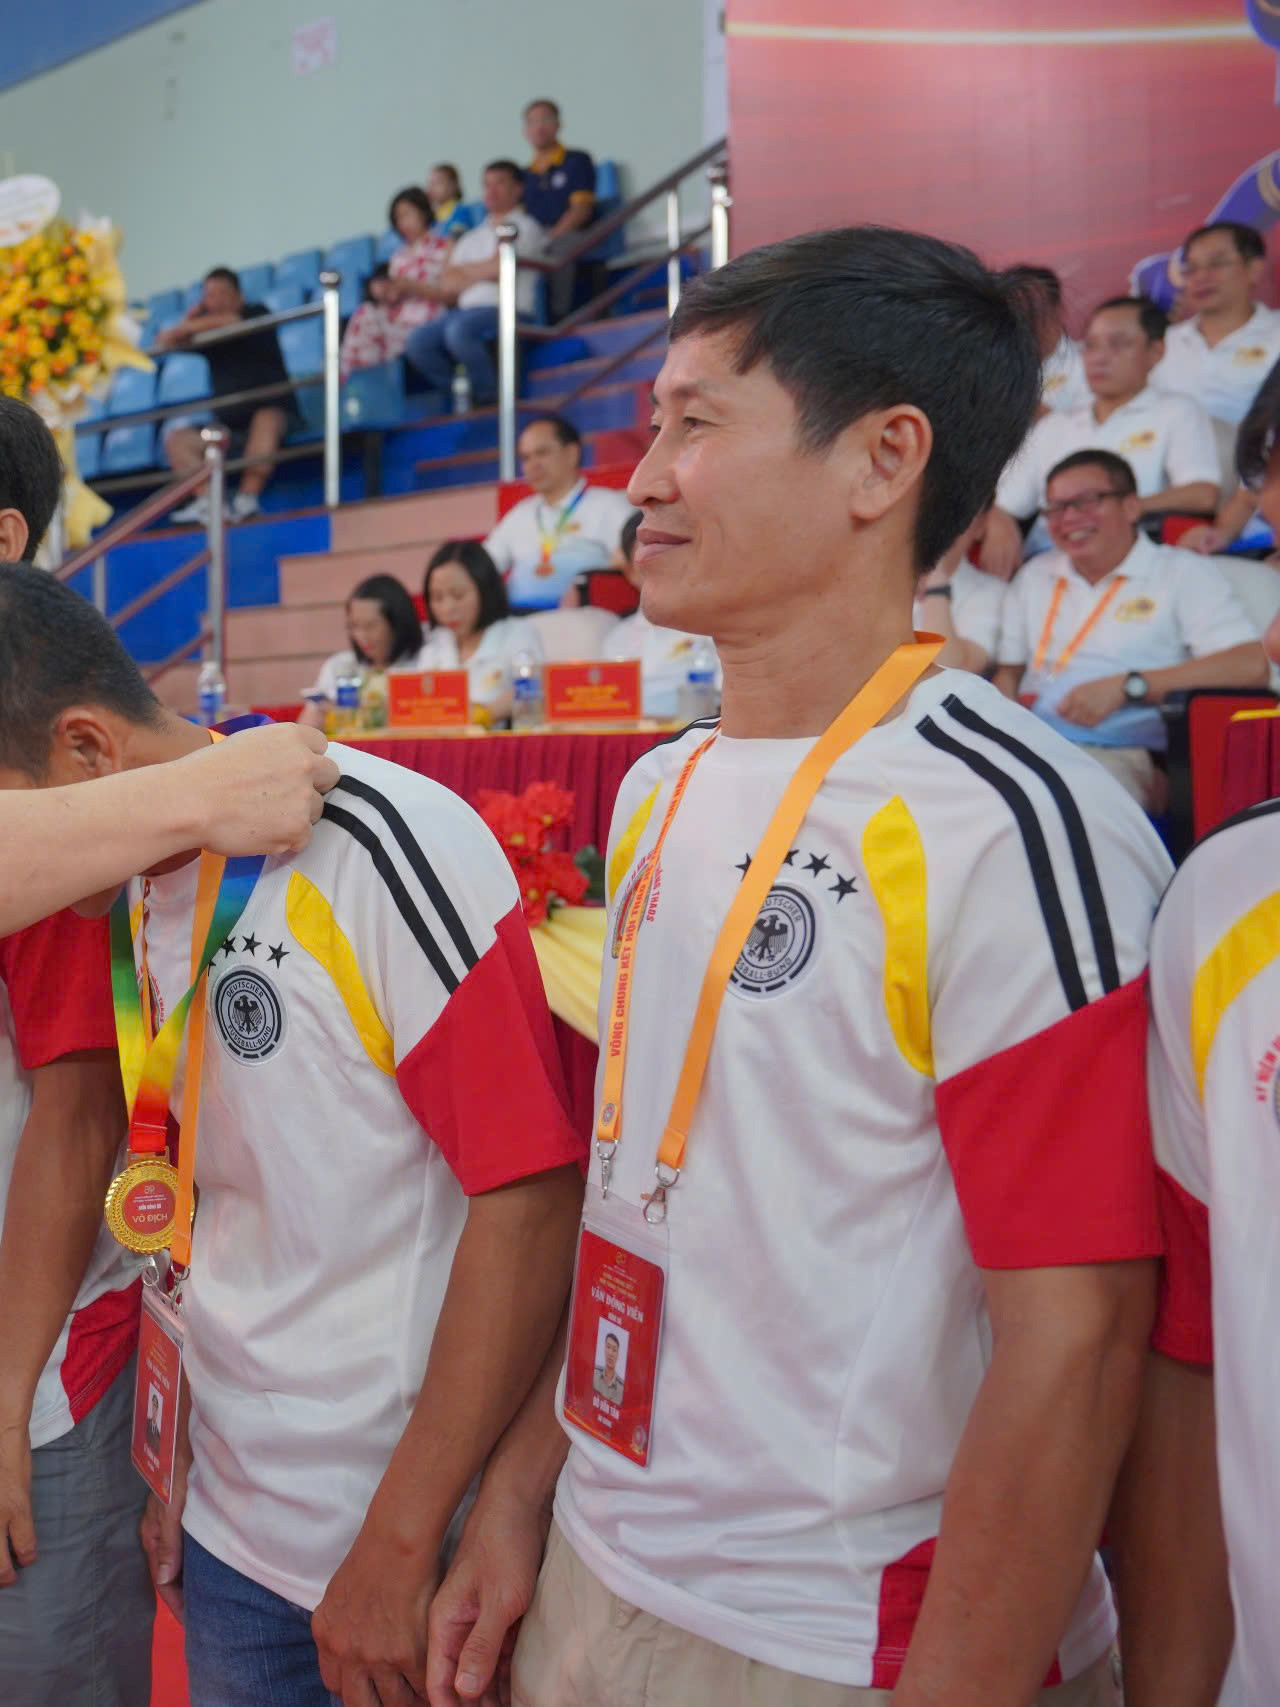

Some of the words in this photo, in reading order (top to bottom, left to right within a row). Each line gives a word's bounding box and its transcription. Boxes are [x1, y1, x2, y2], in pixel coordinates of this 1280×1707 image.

[763, 898, 803, 923] UTSCHER
[226, 981, 264, 999] DEUTSCHER
[615, 973, 629, 1018] CHUNG
[227, 1024, 272, 1049] FUSSBALL-BUND
[132, 1213, 146, 1223] VÔ
[146, 1212, 169, 1223] ĐỊCH
